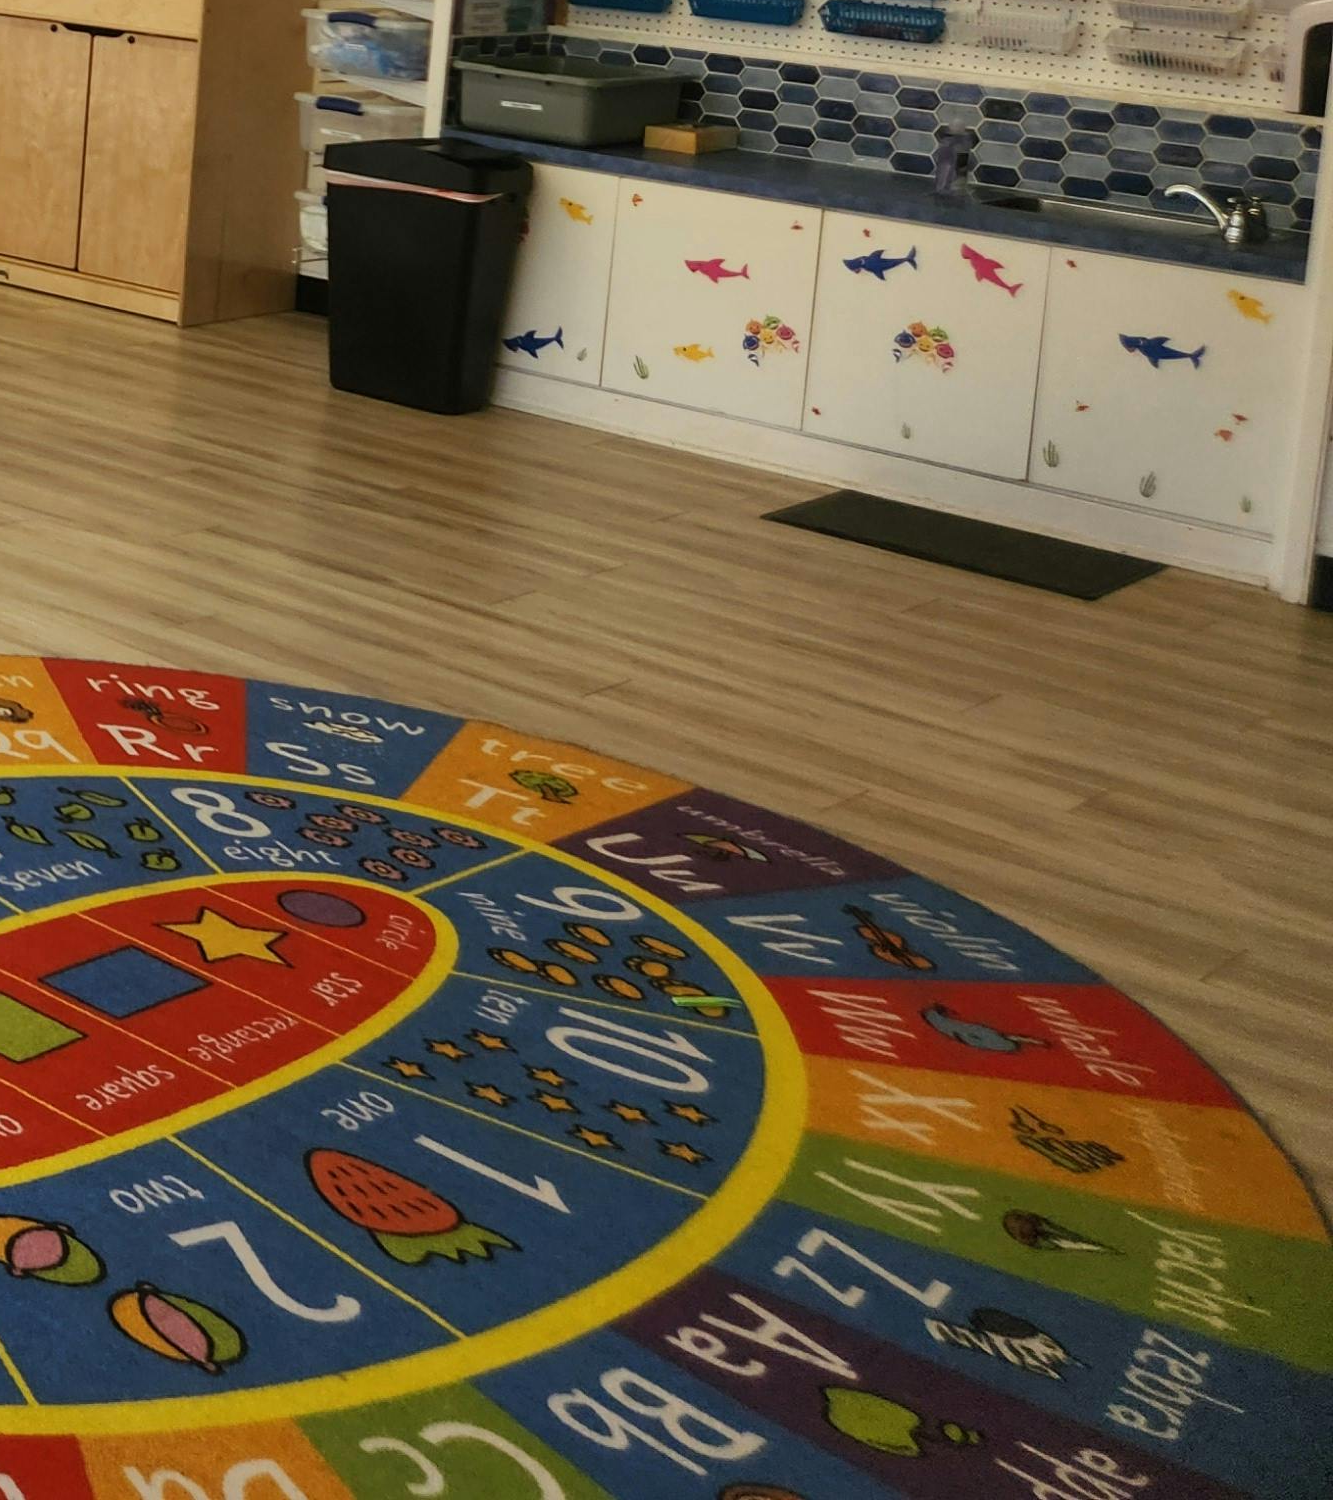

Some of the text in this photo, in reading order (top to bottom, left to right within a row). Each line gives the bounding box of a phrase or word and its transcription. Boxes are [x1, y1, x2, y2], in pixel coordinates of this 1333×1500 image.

[85, 674, 223, 711] ring
[267, 694, 426, 738] snow
[97, 722, 221, 767] Rr
[263, 740, 378, 787] Ss
[478, 737, 650, 795] tree
[169, 785, 273, 840] 8
[457, 778, 548, 827] Tt
[222, 839, 342, 873] eight
[585, 833, 725, 895] Uu
[674, 803, 845, 877] umbrella
[374, 911, 429, 952] circle
[475, 890, 527, 943] nine
[516, 884, 643, 923] 9
[727, 913, 845, 967] Vv
[868, 891, 1023, 975] violin
[308, 972, 364, 1009] star
[480, 989, 525, 1026] ten
[187, 1008, 301, 1068] rectangle
[544, 1007, 717, 1094] 10
[806, 988, 919, 1058] Ww
[1016, 994, 1157, 1088] whale
[82, 1062, 178, 1114] square
[318, 1090, 396, 1133] one
[848, 1069, 986, 1145] Xx
[109, 1172, 207, 1213] two
[414, 1135, 570, 1215] 1
[813, 1157, 983, 1234] Yy
[170, 1218, 362, 1325] 2
[773, 1227, 956, 1308] Zz
[666, 1293, 860, 1381] Aa
[1105, 1329, 1245, 1441] zebra
[546, 1366, 769, 1478] Bb
